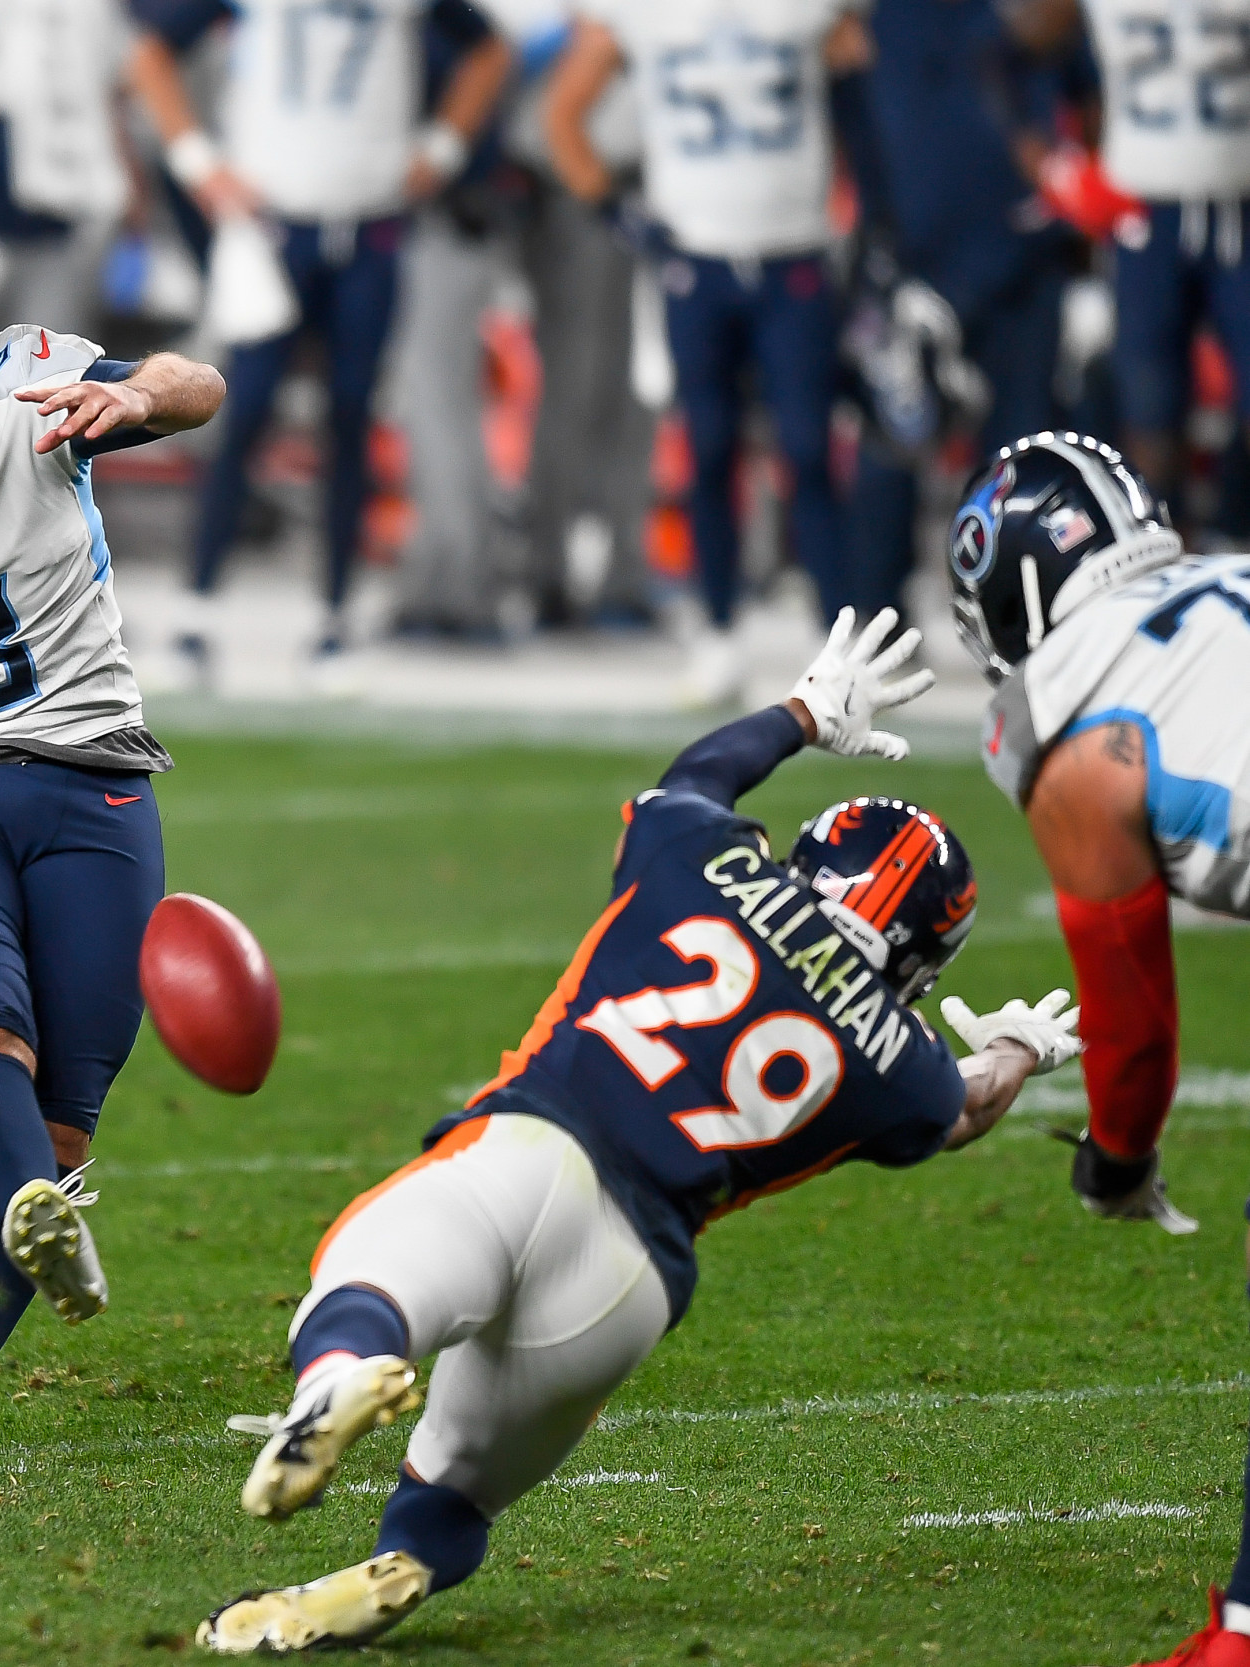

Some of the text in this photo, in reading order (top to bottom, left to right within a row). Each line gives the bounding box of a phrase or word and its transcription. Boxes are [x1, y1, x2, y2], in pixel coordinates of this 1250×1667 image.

[654, 38, 804, 158] 53
[575, 914, 845, 1153] 29
[703, 846, 911, 1075] CALLAHAN
